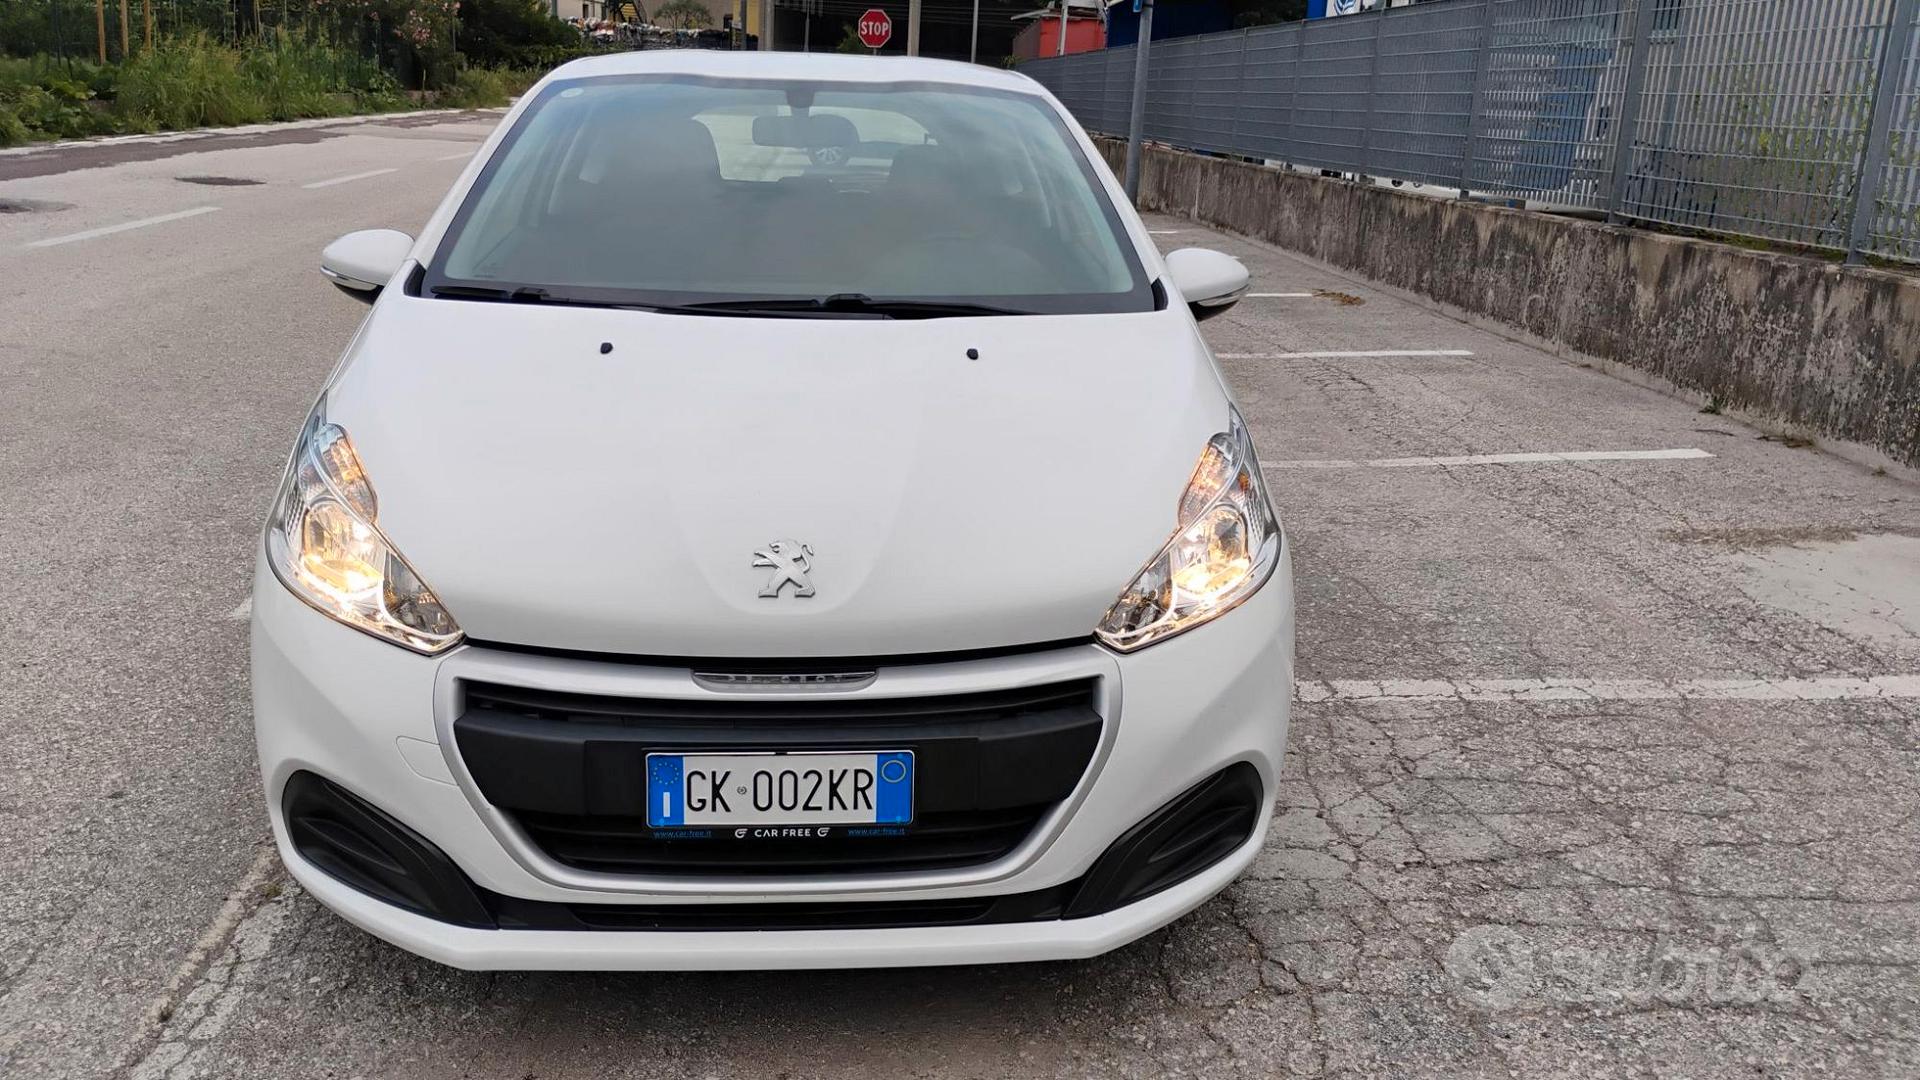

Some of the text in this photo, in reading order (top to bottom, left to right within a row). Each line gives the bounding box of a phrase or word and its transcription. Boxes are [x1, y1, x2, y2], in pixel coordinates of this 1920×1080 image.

[861, 21, 889, 36] STOP
[686, 769, 874, 812] GK 002KR
[663, 791, 671, 818] I
[754, 828, 811, 838] CAR FREE
